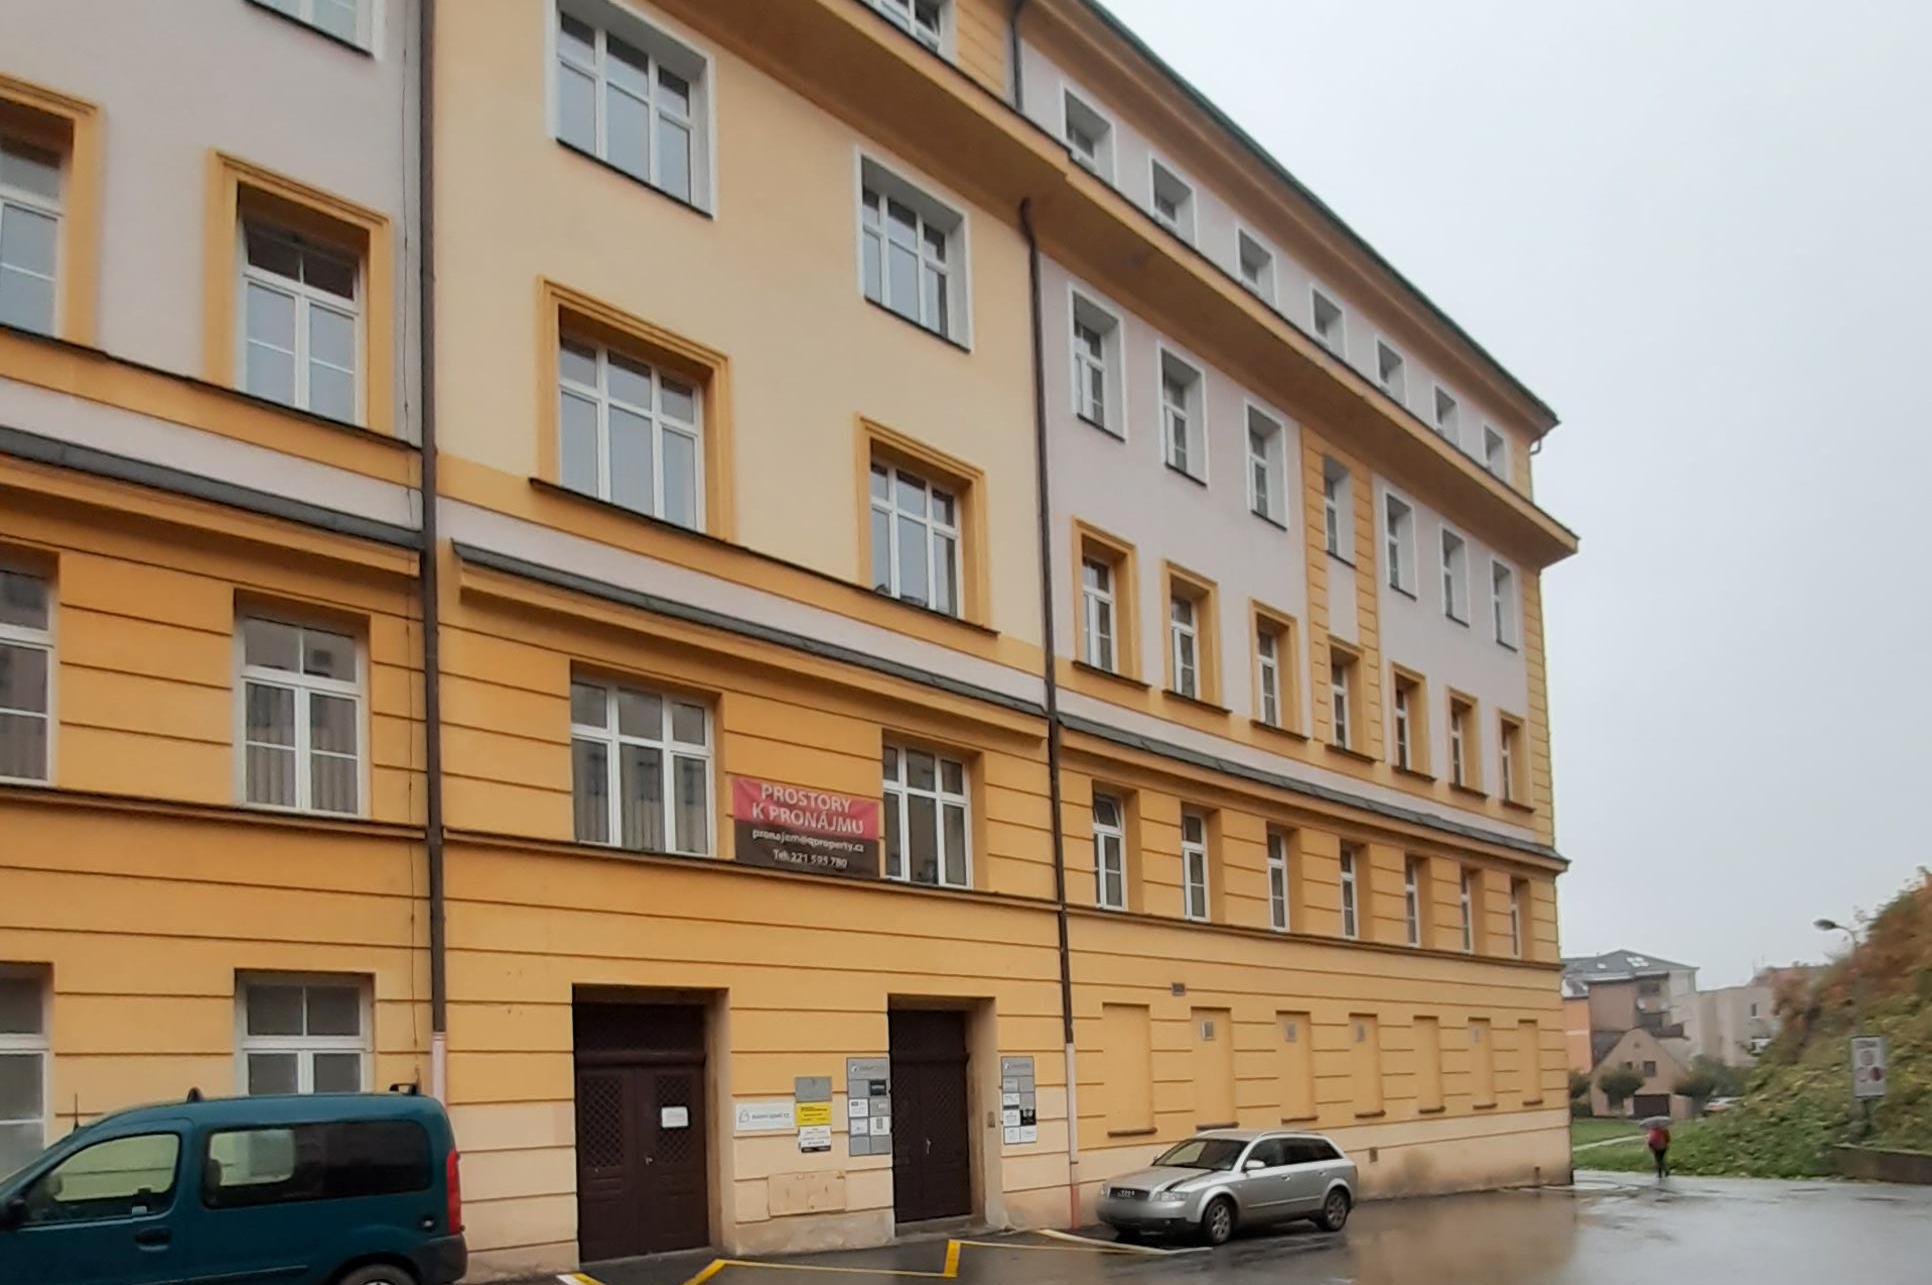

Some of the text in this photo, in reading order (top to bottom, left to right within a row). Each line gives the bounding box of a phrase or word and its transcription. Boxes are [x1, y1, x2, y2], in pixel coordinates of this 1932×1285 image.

[761, 783, 851, 813] PROSTORY
[752, 802, 864, 834] K PRONÁJMU
